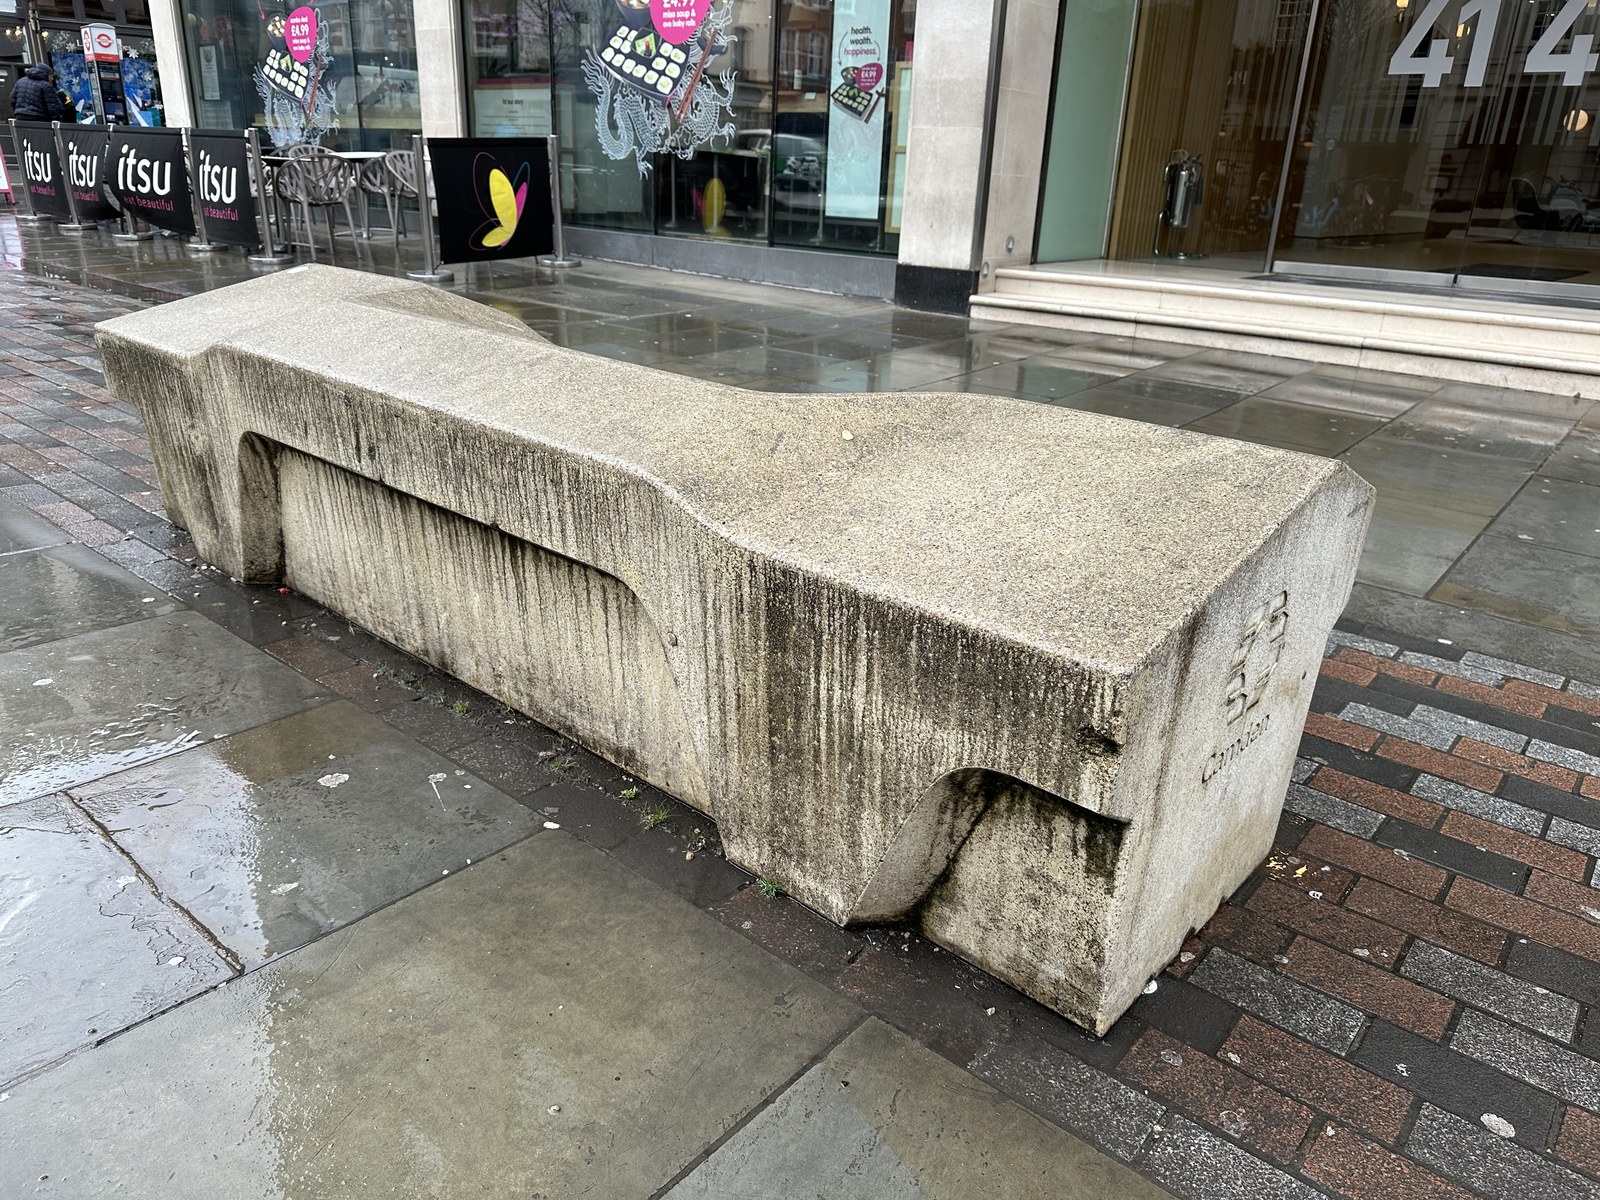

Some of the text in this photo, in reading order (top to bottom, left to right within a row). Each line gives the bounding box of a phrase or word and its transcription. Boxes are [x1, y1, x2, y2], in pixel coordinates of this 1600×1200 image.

[291, 24, 309, 36] £4.99
[662, 8, 696, 19] miso soup &
[672, 19, 685, 28] baby
[1388, 0, 1599, 87] 414
[23, 138, 52, 183] itsu
[68, 141, 97, 188] itsu
[117, 144, 171, 196] itsu
[200, 150, 237, 204] itsu
[123, 195, 175, 212] eat beautiful
[209, 205, 239, 221] beautiful
[1201, 714, 1271, 784] Camden
